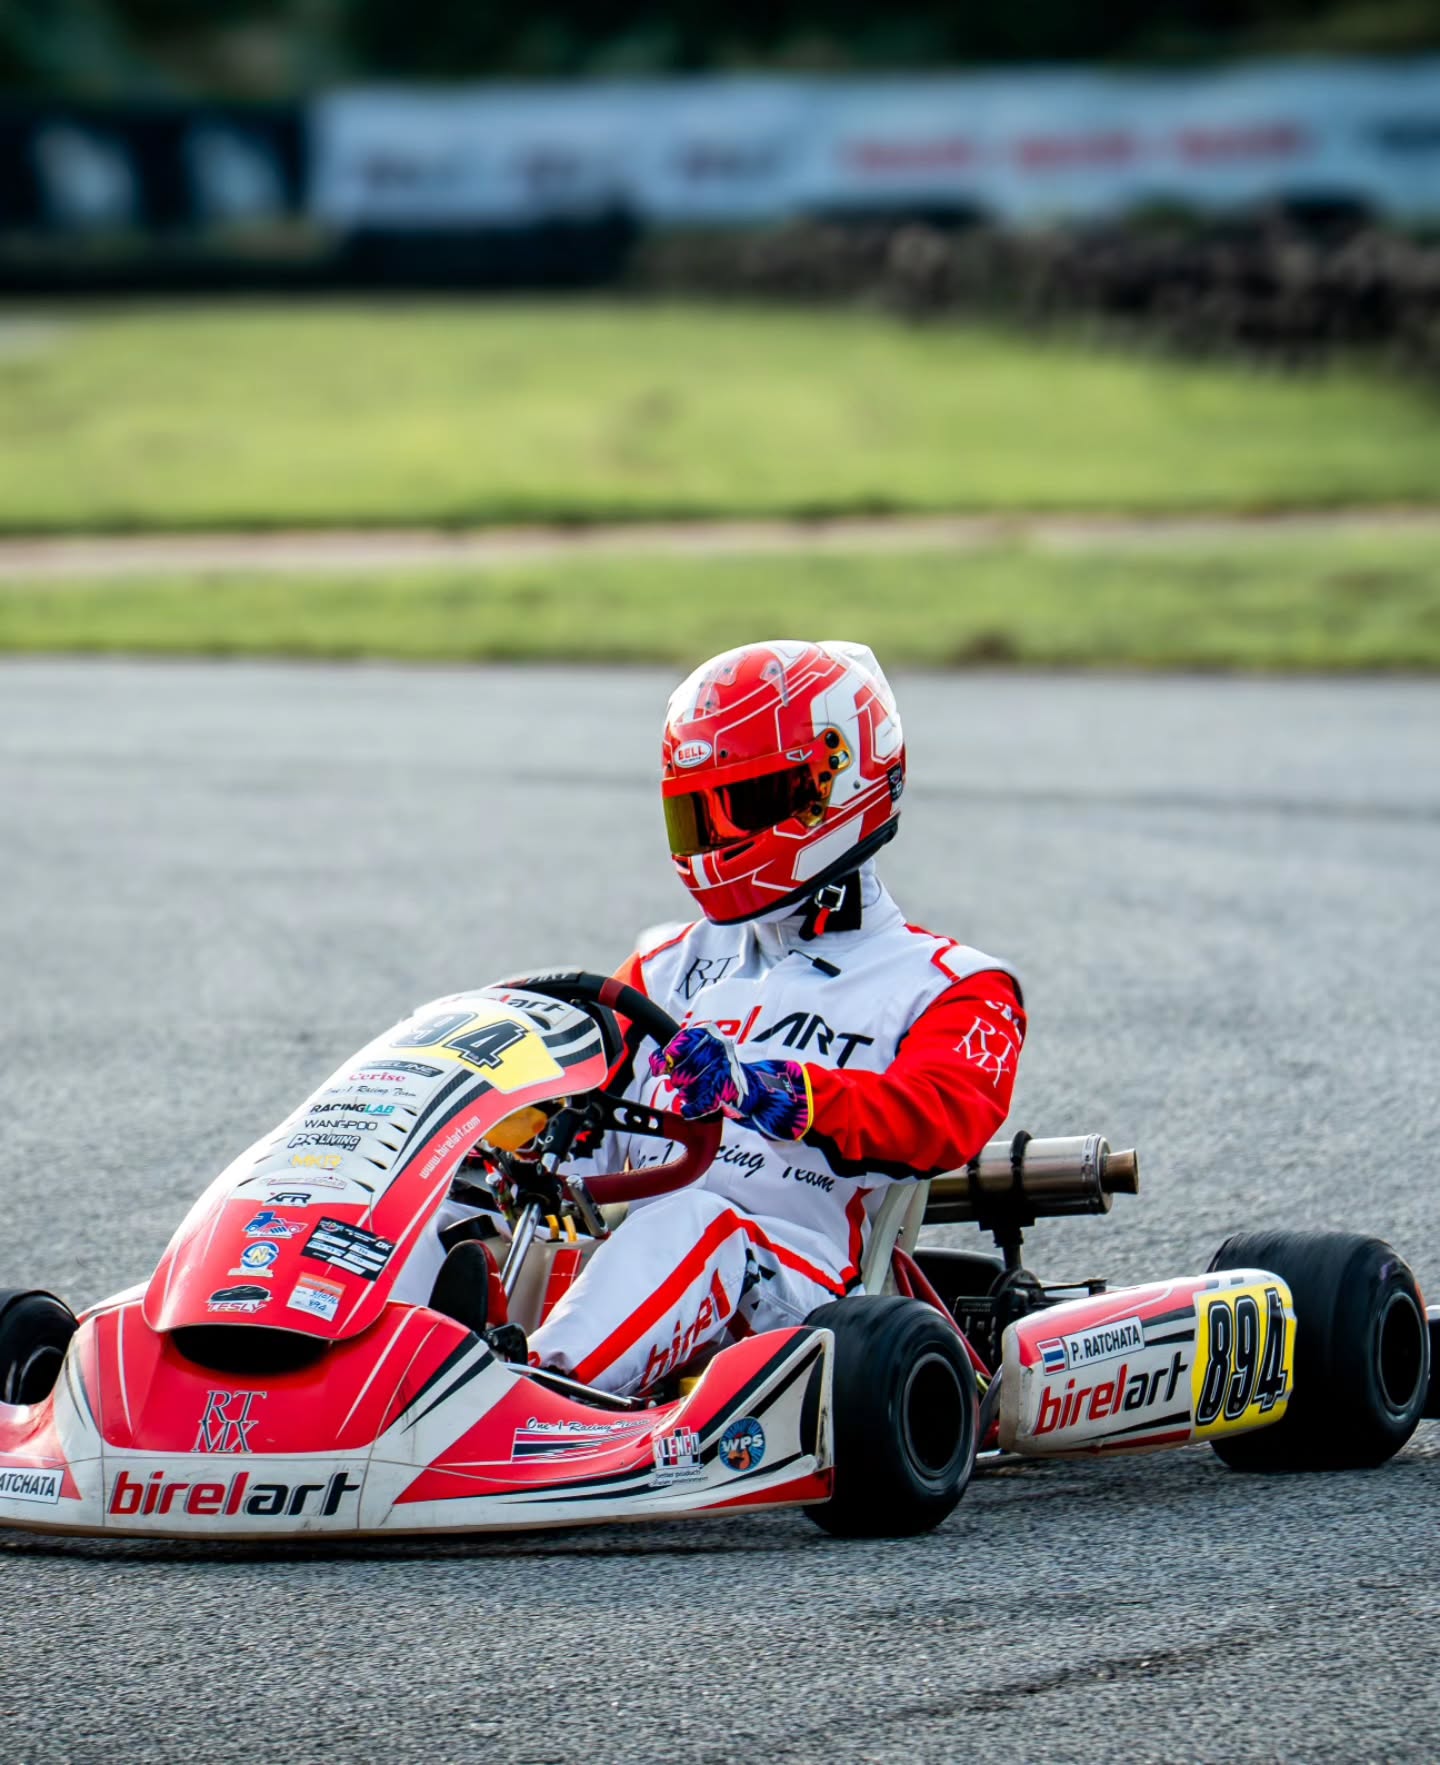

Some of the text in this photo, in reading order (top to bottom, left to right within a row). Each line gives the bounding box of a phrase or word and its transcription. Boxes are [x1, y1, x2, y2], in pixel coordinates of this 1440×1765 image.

[678, 746, 707, 761] BELL
[310, 1103, 396, 1116] RACINGLAB
[714, 1144, 765, 1178] cing
[1070, 1324, 1141, 1362] P. RATCHATA
[1194, 1286, 1290, 1427] 894
[201, 1390, 268, 1424] RT
[1033, 1351, 1189, 1436] birelart
[190, 1420, 259, 1454] MX
[654, 1434, 700, 1458] KLENCO
[722, 1434, 762, 1452] WPS
[107, 1470, 361, 1516] birelart
